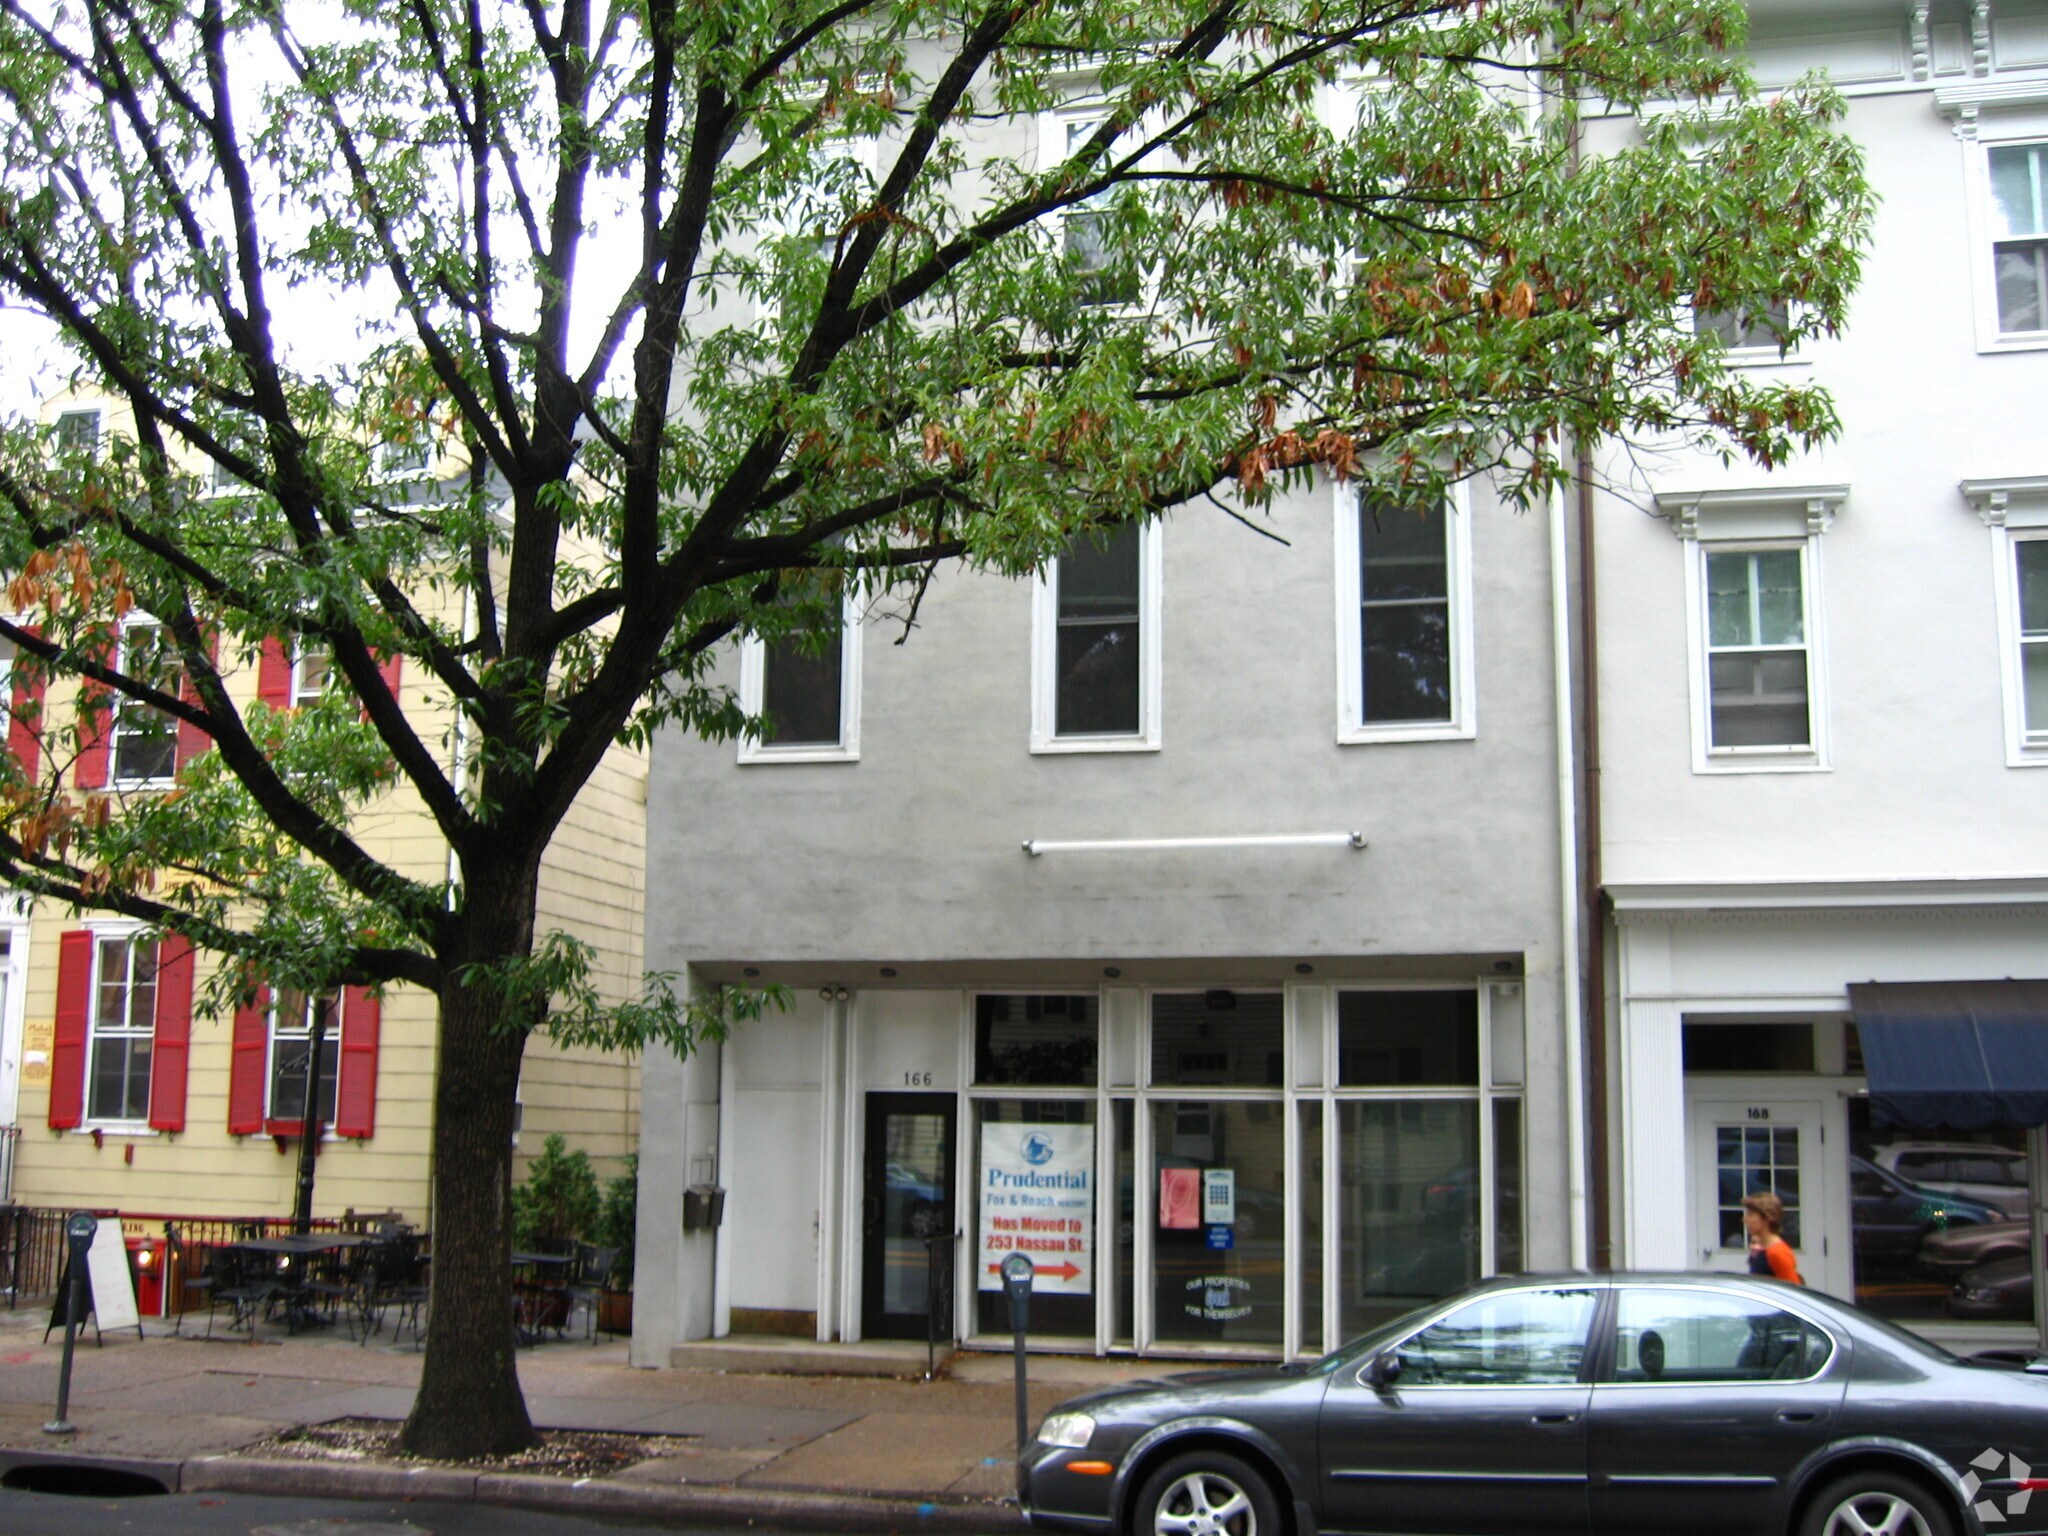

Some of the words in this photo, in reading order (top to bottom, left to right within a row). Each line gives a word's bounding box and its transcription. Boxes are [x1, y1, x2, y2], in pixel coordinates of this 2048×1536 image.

[905, 1072, 932, 1086] 166
[1747, 1107, 1769, 1119] 168
[988, 1168, 1087, 1189] Prudential
[986, 1194, 1005, 1206] Fox
[1009, 1194, 1018, 1206] &
[1021, 1194, 1054, 1207] Roach
[993, 1216, 1018, 1231] Has
[1021, 1217, 1066, 1232] Moved
[1068, 1218, 1082, 1233] to
[986, 1235, 1012, 1250] 253
[1016, 1236, 1065, 1252] Nassau
[1068, 1238, 1085, 1253] St.
[1185, 1278, 1203, 1291] OUR
[1204, 1276, 1251, 1291] PROPERTIES
[1185, 1305, 1202, 1318] FOR
[1203, 1305, 1253, 1320] THEMSELVES
